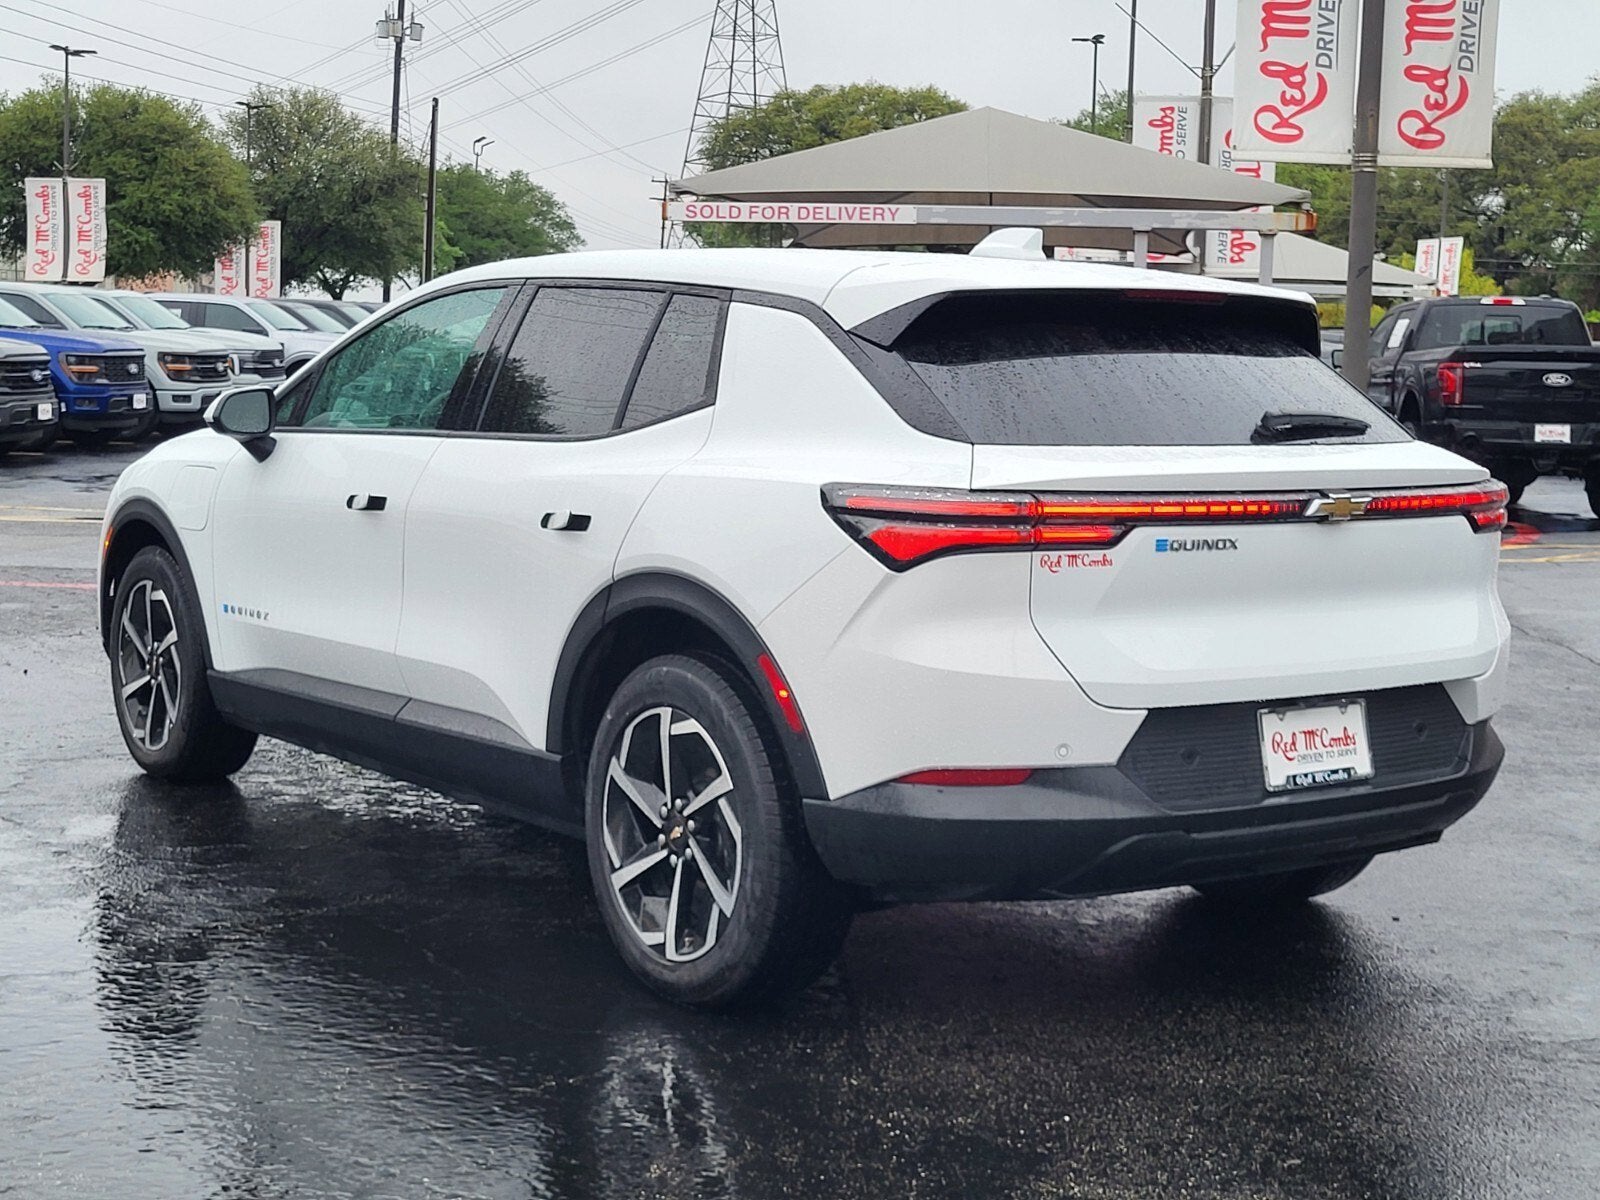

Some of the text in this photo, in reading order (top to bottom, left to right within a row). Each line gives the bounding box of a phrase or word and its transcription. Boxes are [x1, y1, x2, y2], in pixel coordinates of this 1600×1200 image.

[1315, 0, 1336, 70] DRIVE
[1457, 0, 1479, 73] DRIVE
[1253, 0, 1328, 144] Red M
[1397, 0, 1469, 150] Red M
[1175, 105, 1188, 147] SERVE
[51, 211, 57, 220] TO
[93, 211, 100, 220] TO
[685, 204, 901, 222] SOLD FOR DELIVERY
[32, 184, 55, 275] Red McCombs
[50, 223, 58, 252] DRIVEN
[74, 184, 98, 275] Red McCombs
[1217, 232, 1229, 263] ERVE
[219, 275, 239, 296] Red
[255, 276, 274, 299] Red
[1155, 537, 1239, 553] EQUINOX
[1039, 553, 1114, 574] Red McCombs
[1271, 726, 1357, 762] Red McCombs
[1297, 747, 1358, 763] DRIVEN TO SERVE
